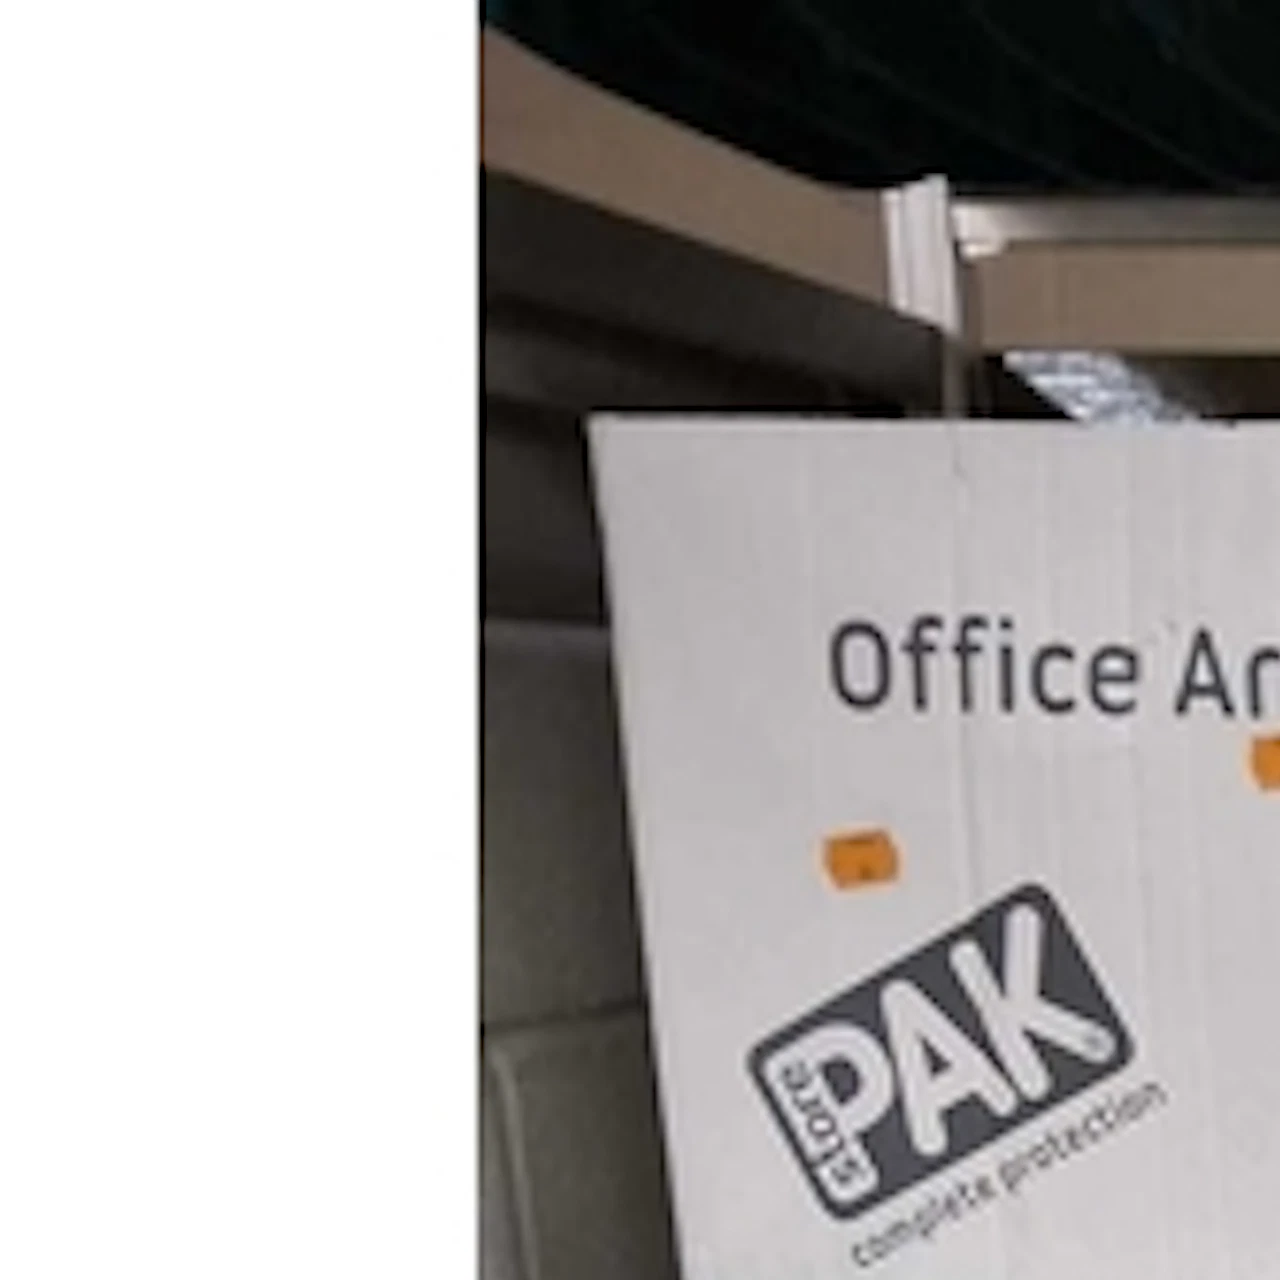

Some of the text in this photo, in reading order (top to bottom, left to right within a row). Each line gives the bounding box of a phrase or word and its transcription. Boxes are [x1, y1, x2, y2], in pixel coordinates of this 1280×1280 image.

[829, 615, 1142, 714] Office
[762, 902, 1119, 1200] PAK
[779, 1060, 869, 1184] store
[850, 1081, 1169, 1269] complete protection
